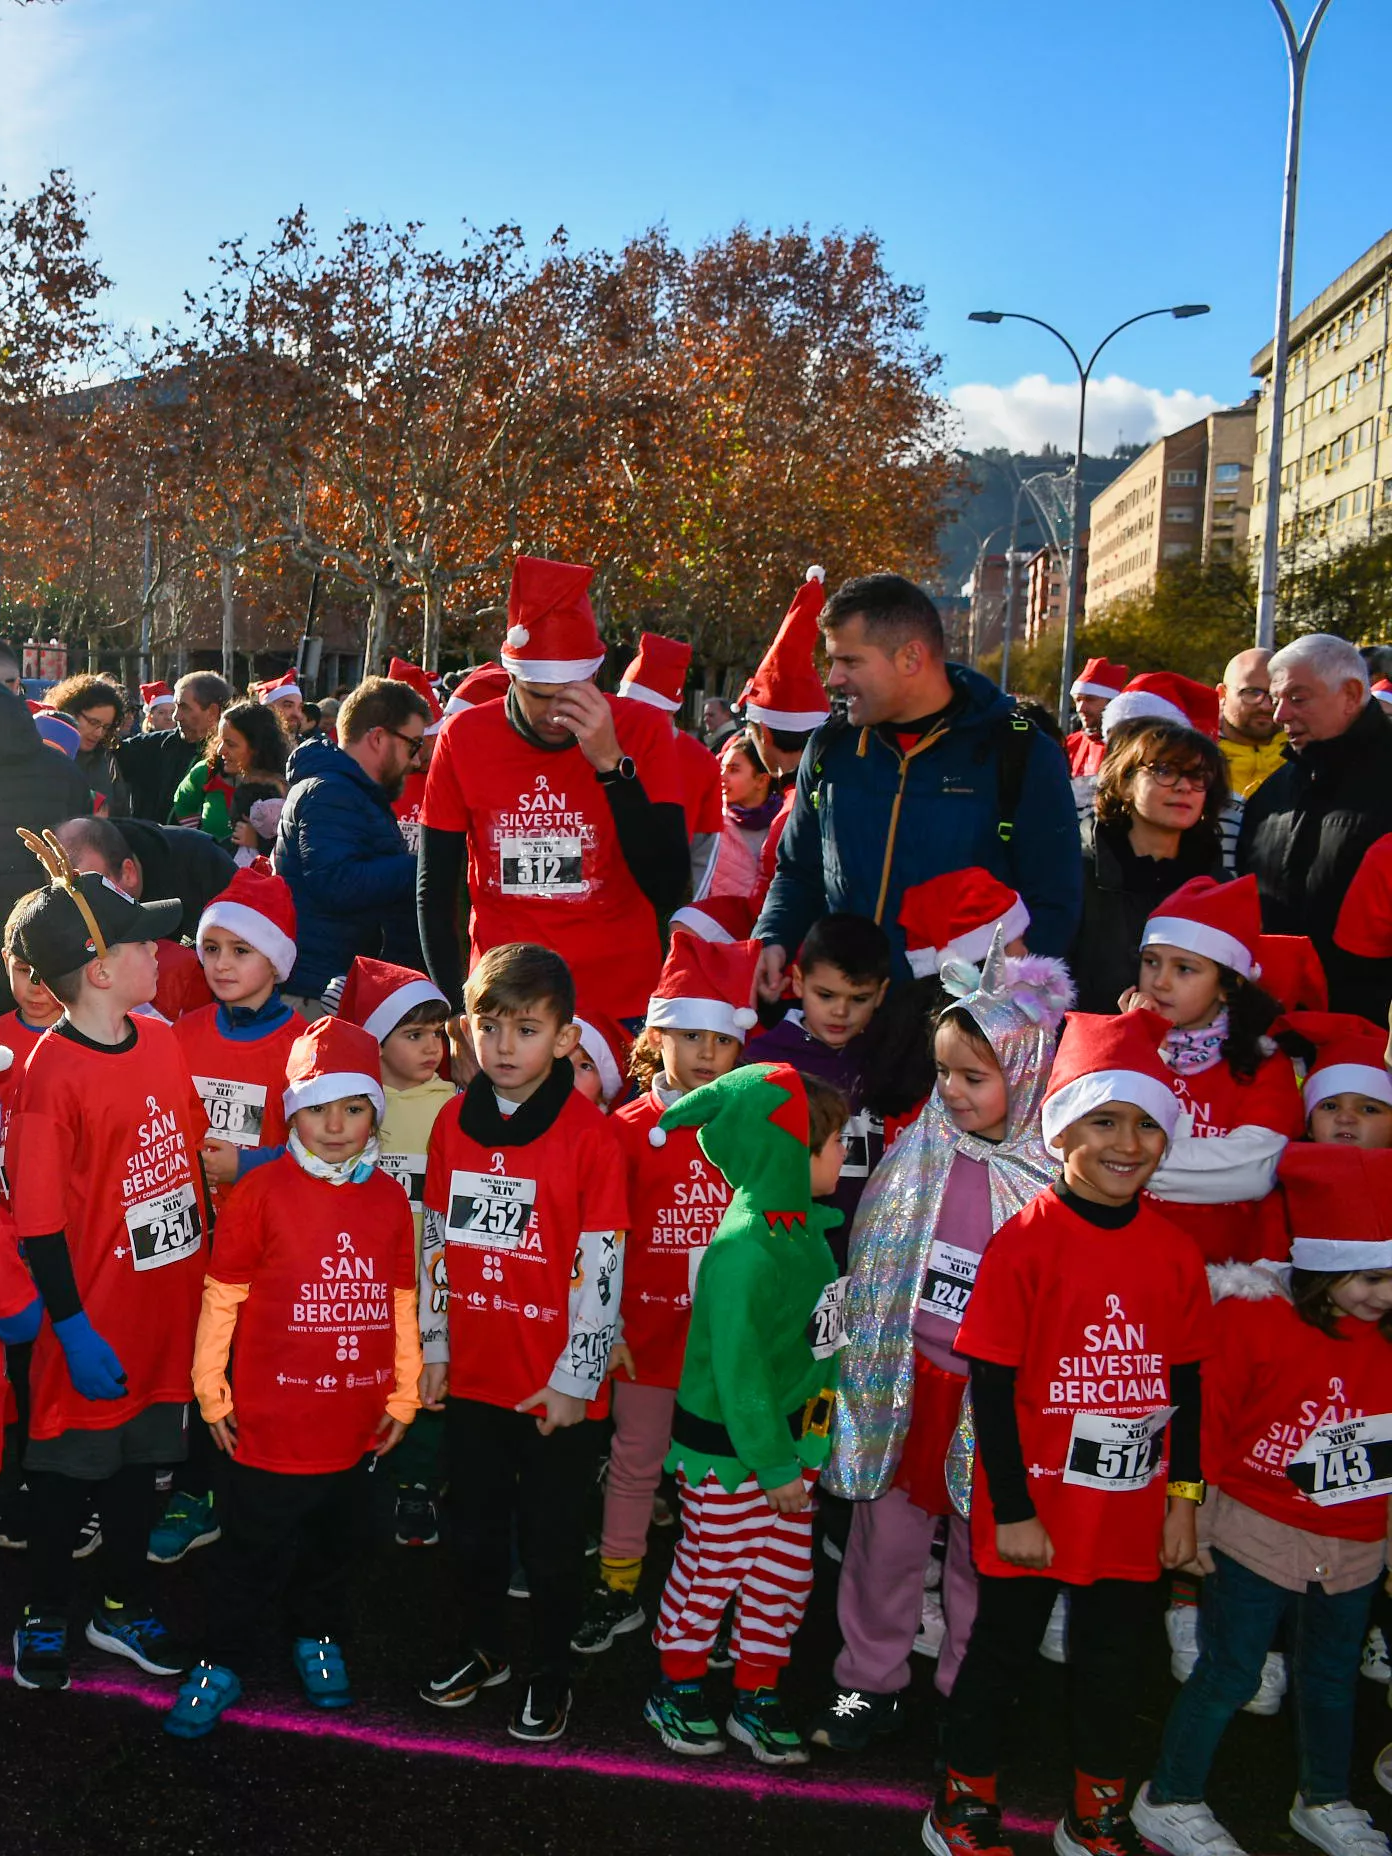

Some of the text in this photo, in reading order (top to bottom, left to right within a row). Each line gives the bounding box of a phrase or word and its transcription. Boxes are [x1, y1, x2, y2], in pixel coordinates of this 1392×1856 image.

[518, 793, 566, 812] SAN
[500, 812, 583, 827] SILVESTRE
[517, 857, 561, 884] 312
[215, 1087, 237, 1098] XLIV
[137, 1110, 177, 1148] SAN
[491, 1185, 515, 1197] XLIV
[493, 1178, 522, 1188] SILVESTRE
[673, 1182, 727, 1205] SAN
[149, 1200, 162, 1209] SAN
[162, 1199, 182, 1213] XLIV
[469, 1198, 522, 1236] 252
[658, 1207, 727, 1225] SILVEST
[149, 1209, 194, 1254] 254
[510, 1251, 547, 1264] AYUDANDO
[940, 1253, 952, 1261] SAN
[320, 1256, 374, 1280] SAN
[949, 1263, 973, 1276] XLIV
[300, 1282, 387, 1301] SILVESTRE
[932, 1280, 972, 1310] 1247
[293, 1302, 389, 1323] BERCIANA
[314, 1325, 346, 1333] COMPARTE
[348, 1324, 366, 1332] TIEMPO
[1084, 1324, 1145, 1352] SAN
[1058, 1354, 1163, 1378] SILVESTRE
[1049, 1378, 1167, 1404] BERCIANA
[1126, 1426, 1149, 1440] XLIV
[1330, 1421, 1366, 1436] SILVESTRE
[1329, 1430, 1357, 1446] XLIV
[1096, 1439, 1151, 1478] 512
